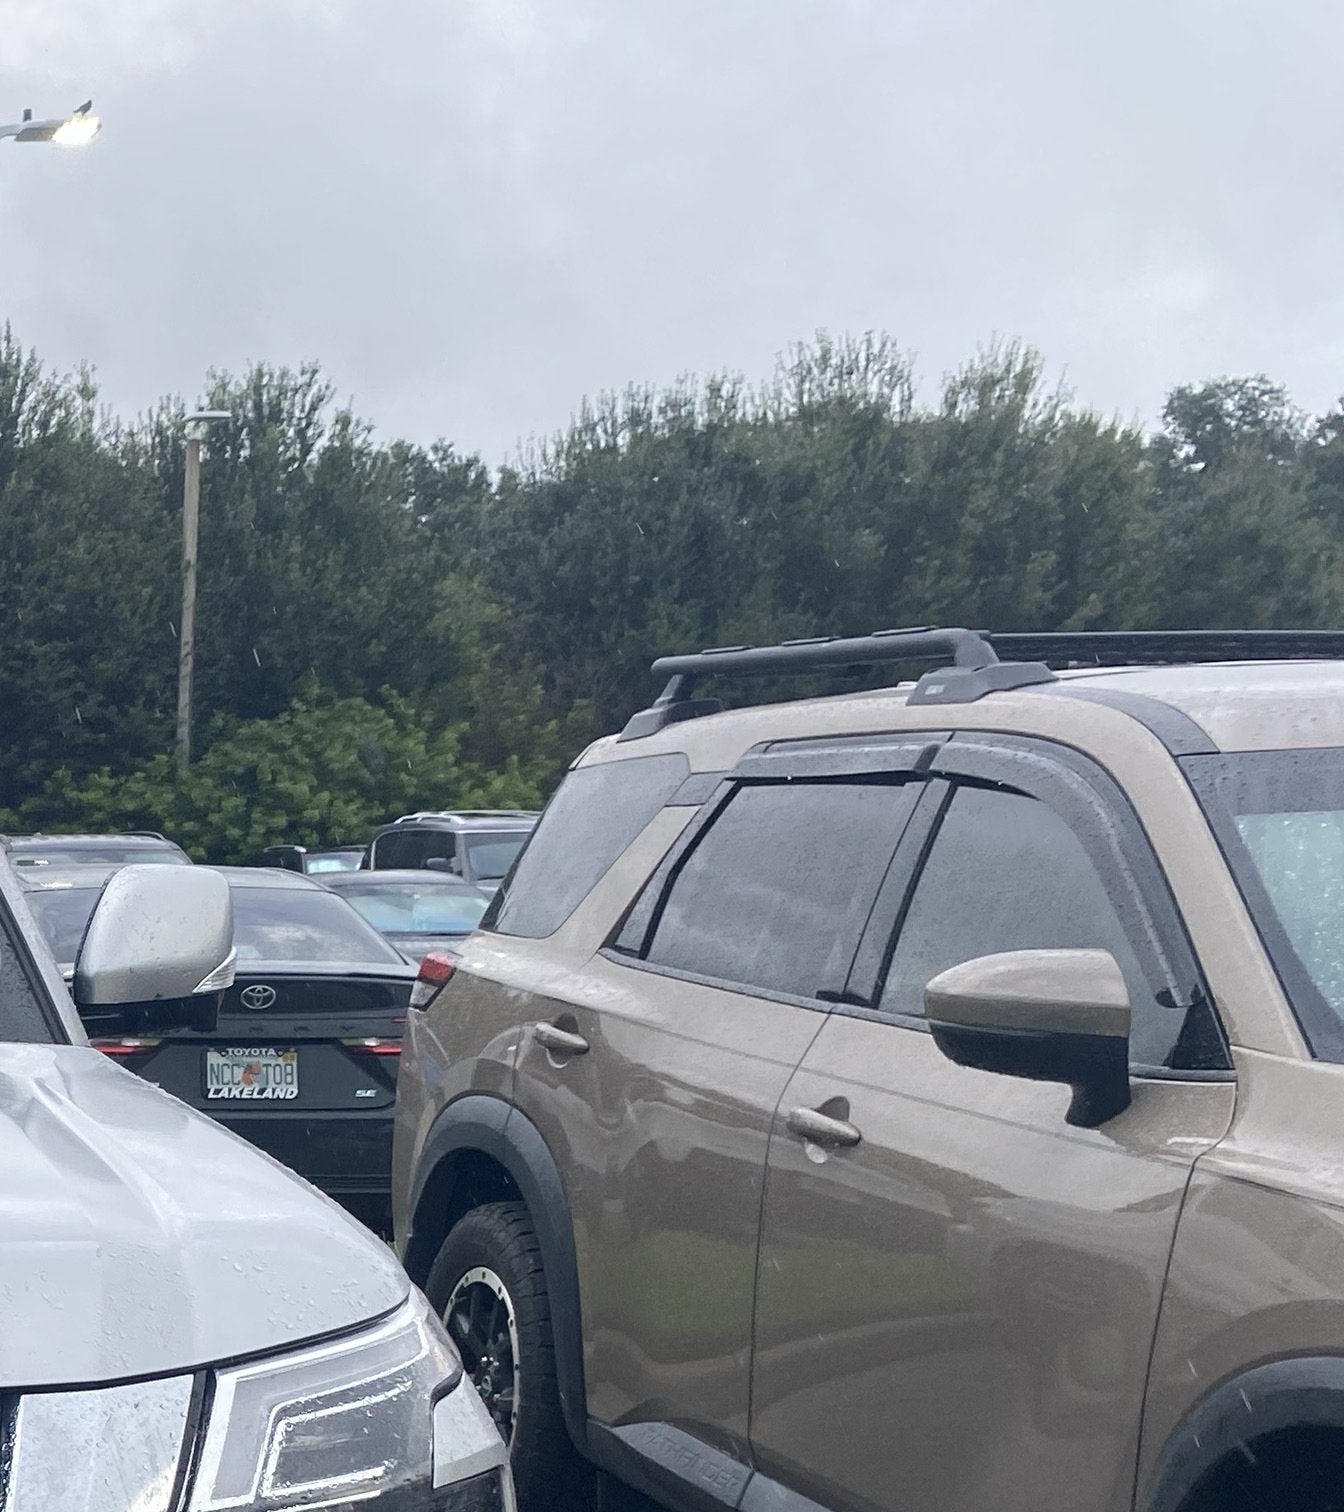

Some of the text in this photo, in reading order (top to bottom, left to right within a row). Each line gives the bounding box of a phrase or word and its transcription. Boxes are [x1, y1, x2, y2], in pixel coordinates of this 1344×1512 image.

[226, 1047, 276, 1056] TOYOTA
[209, 1063, 241, 1086] NCC
[207, 1087, 298, 1100] LAKELAND
[355, 1089, 377, 1097] SE
